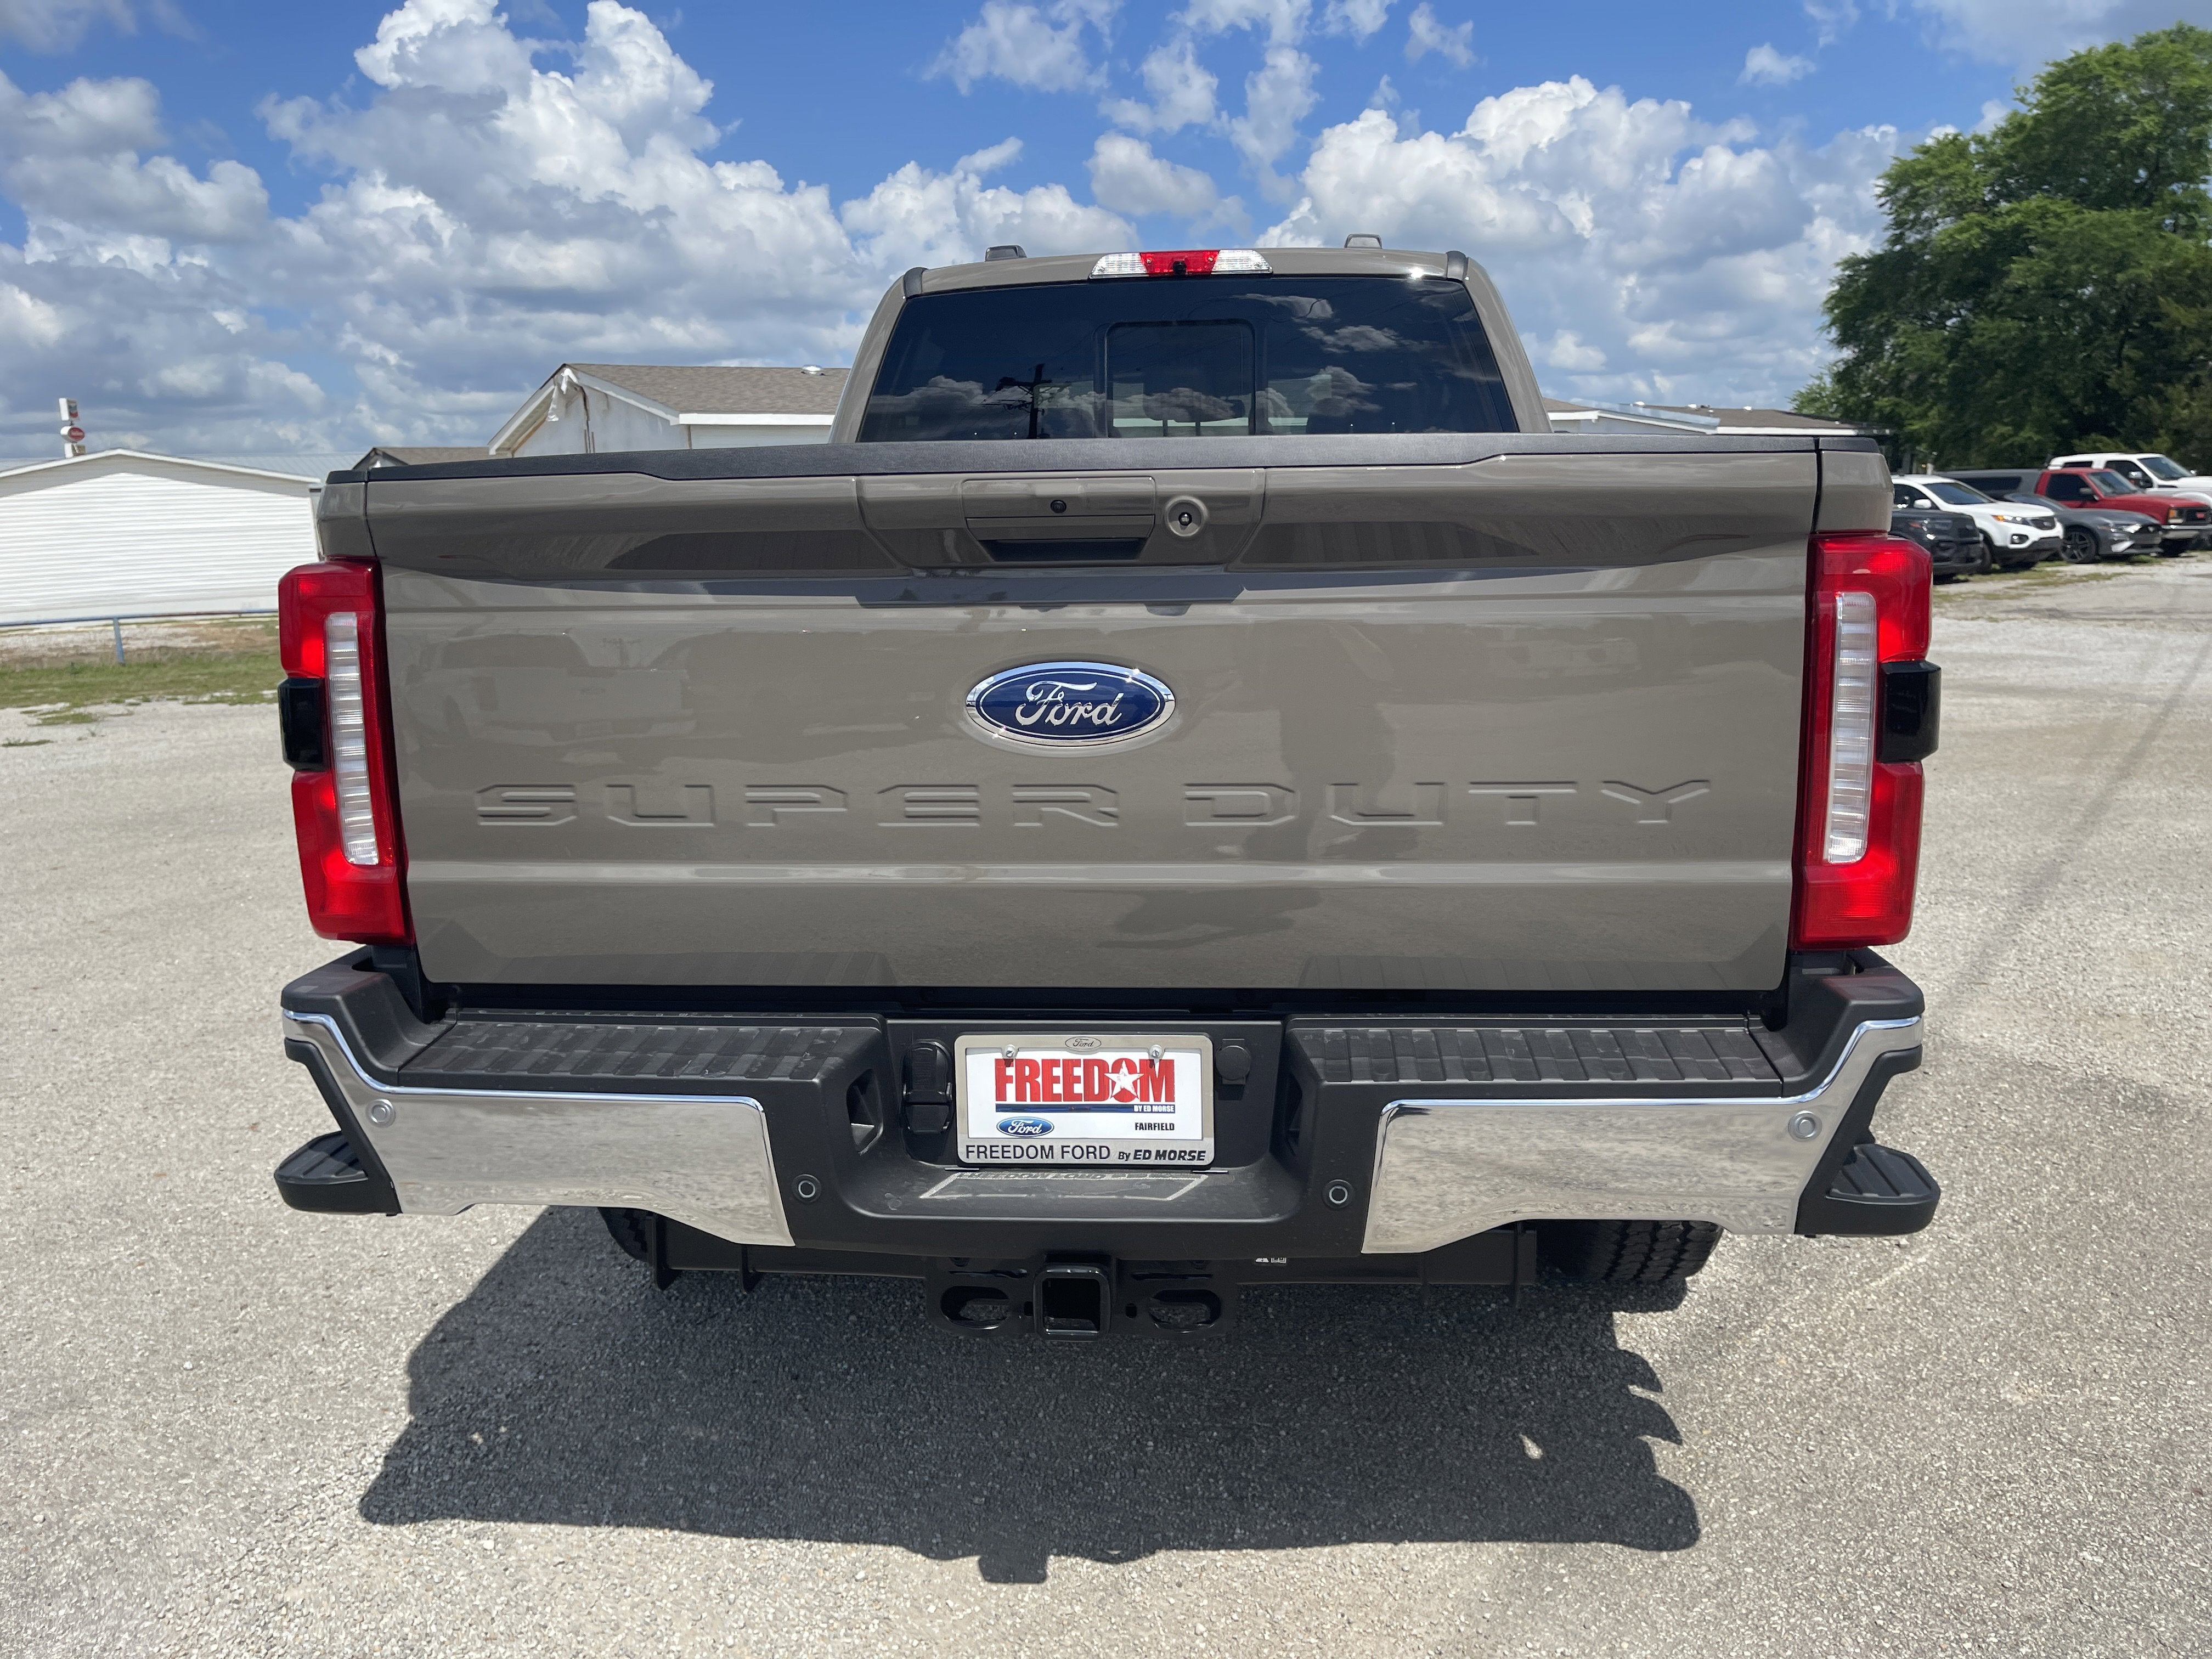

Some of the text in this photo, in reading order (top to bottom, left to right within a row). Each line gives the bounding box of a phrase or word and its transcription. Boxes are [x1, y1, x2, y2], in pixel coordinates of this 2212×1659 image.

[1015, 680, 1125, 725] Ford
[476, 779, 1711, 827] SUPER DUTY
[995, 1058, 1175, 1102] FREEDOM
[1008, 1120, 1042, 1133] Ford
[1135, 1122, 1175, 1131] FAIRFIELD
[966, 1145, 1206, 1161] FREEDOM FORD By ED MORSE
